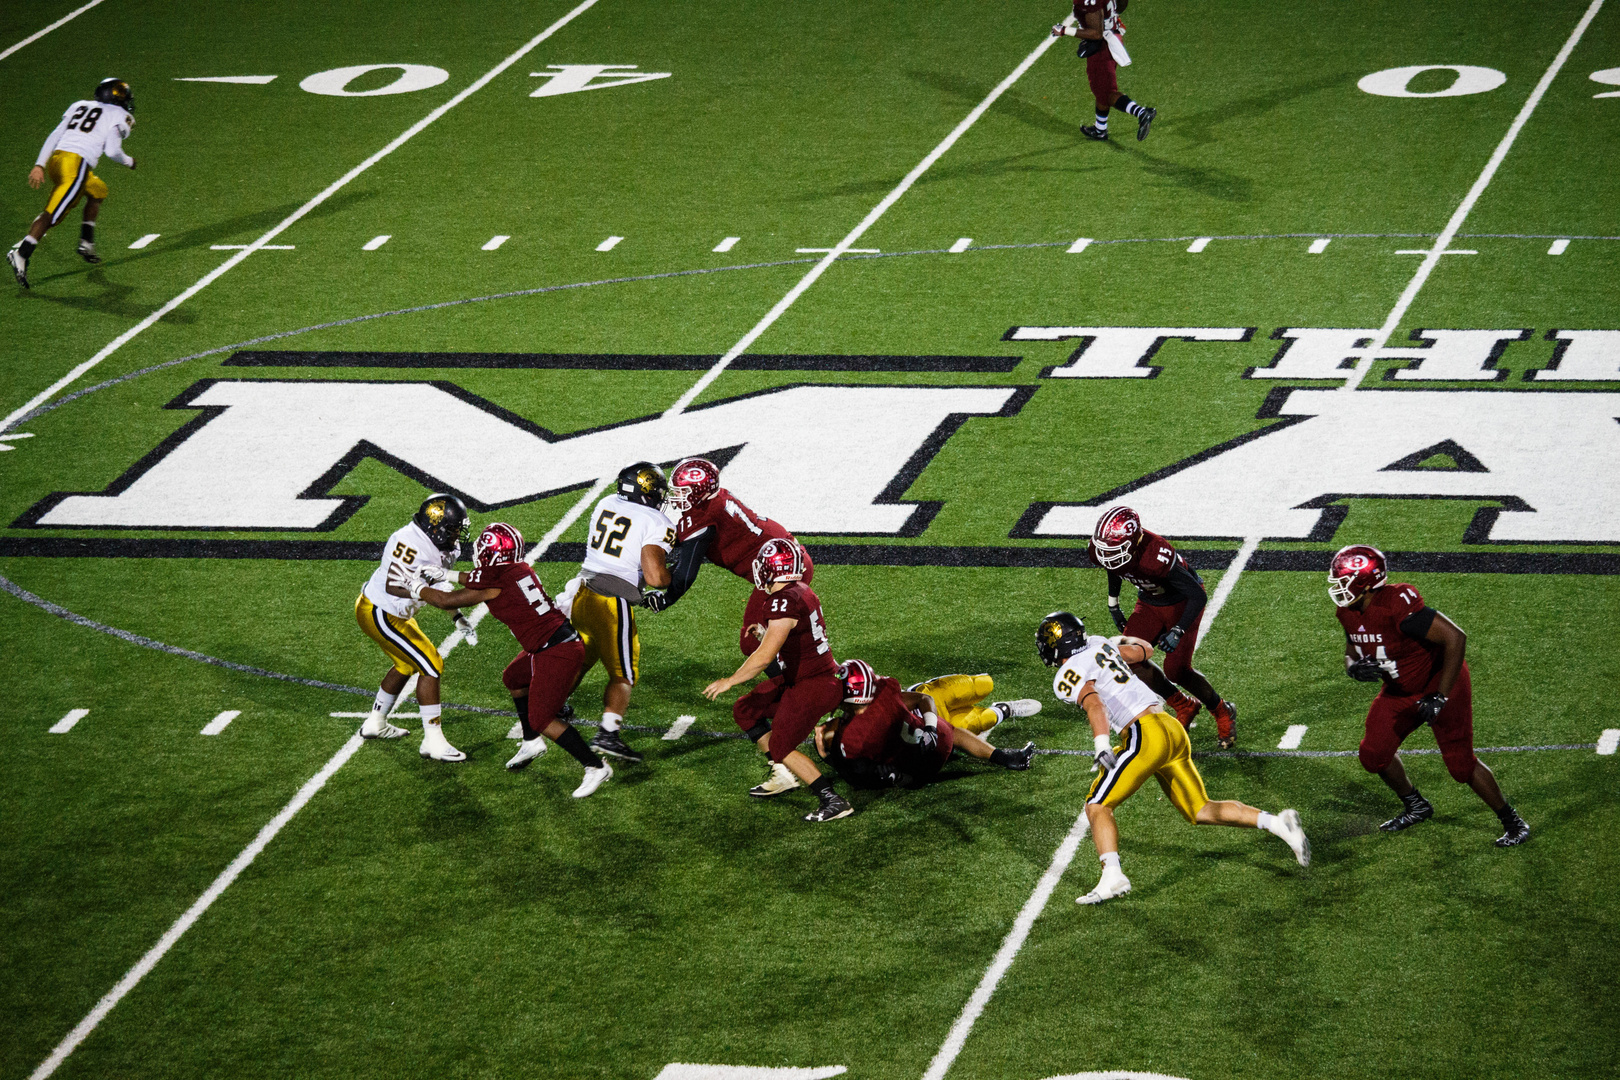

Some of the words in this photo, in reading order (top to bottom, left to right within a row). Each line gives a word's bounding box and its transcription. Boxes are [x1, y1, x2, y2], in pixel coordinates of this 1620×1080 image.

[67, 105, 103, 134] 28
[591, 509, 632, 558] 52
[392, 541, 418, 565] 55
[771, 599, 788, 612] 52
[1058, 669, 1082, 697] 32
